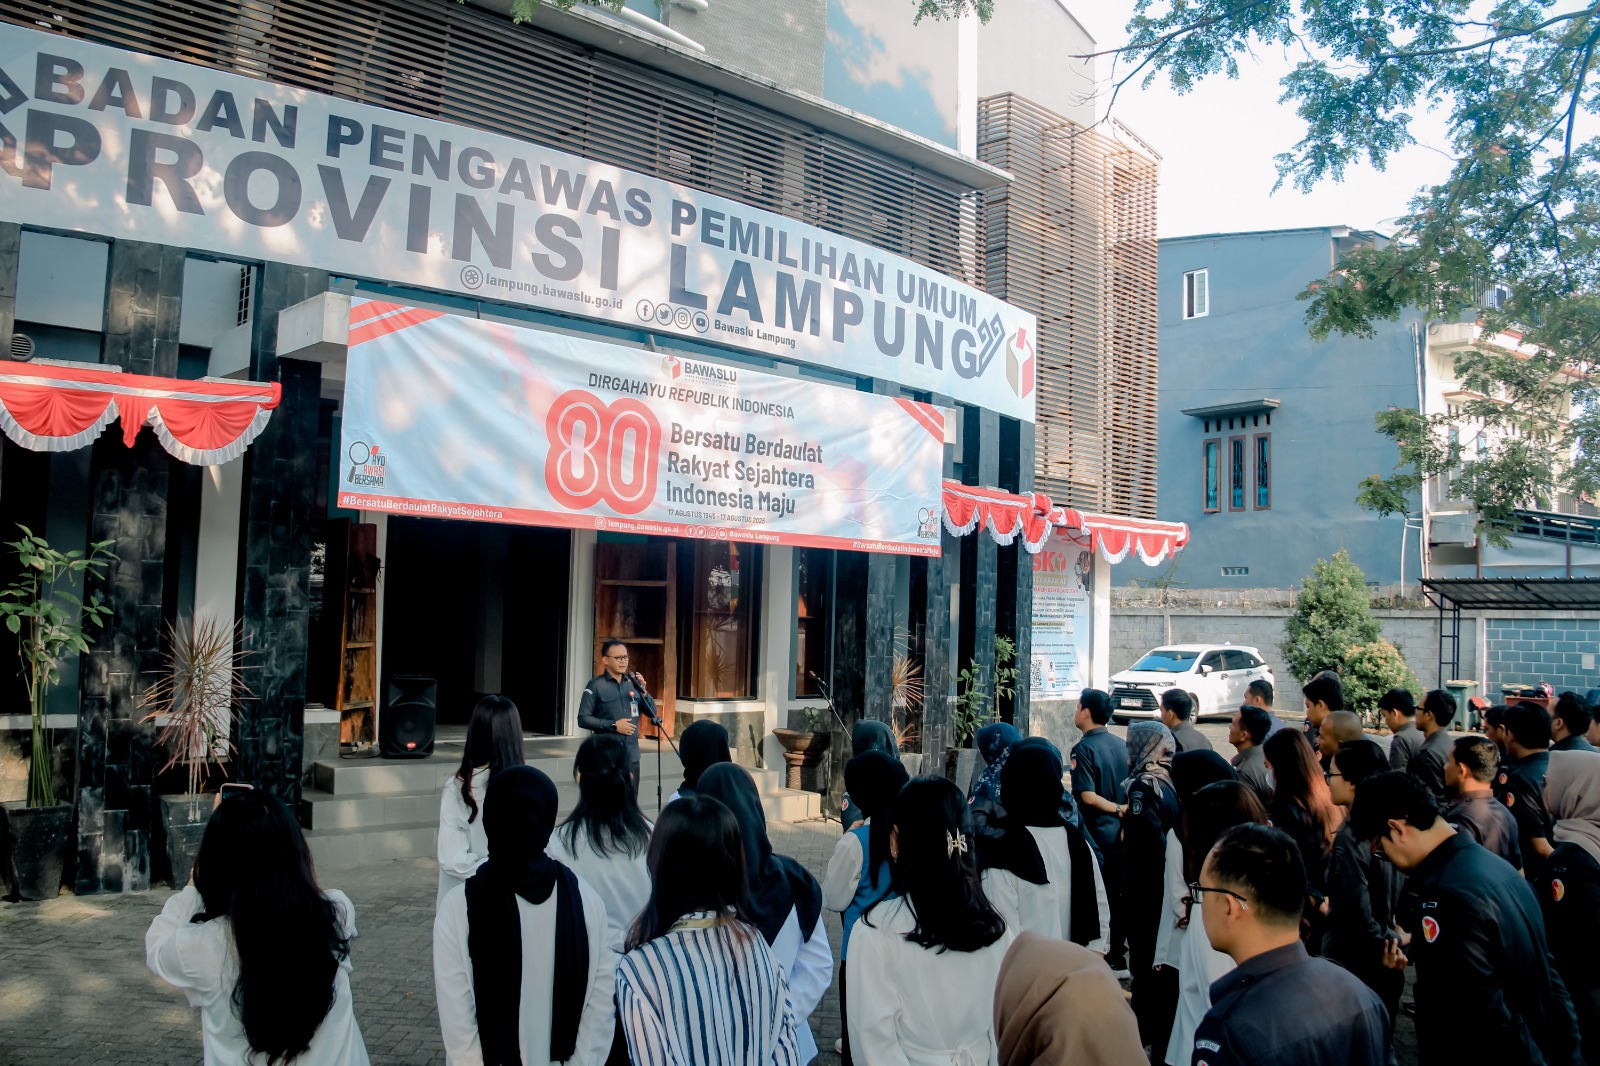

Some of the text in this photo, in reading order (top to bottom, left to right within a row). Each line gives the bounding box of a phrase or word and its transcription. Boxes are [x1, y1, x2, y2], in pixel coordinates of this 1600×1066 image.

[34, 52, 977, 327] BADAN PENGAWAS PEMILIHAN UMUM
[22, 108, 979, 379] PROVINSI LAMPUNG
[486, 273, 622, 309] lampung.bawaslu.go.id
[714, 320, 796, 348] Bawaslu Lampung
[685, 362, 736, 382] BAWASLU
[589, 373, 666, 398] DIRGAHAYU
[669, 387, 729, 409] REPUBLIK
[732, 398, 795, 419] INDONESIA
[545, 389, 661, 515] 80
[671, 422, 823, 463] Bersatu Berdaulat
[363, 464, 385, 477] AWASI
[372, 455, 386, 466] AYO
[668, 451, 815, 489] Rakyat Sejahtera
[354, 474, 384, 487] BERSAMA
[343, 495, 503, 518] #BersatuBerdaulatRakyatSejahtera
[666, 480, 796, 518] Indonesia Maju
[608, 519, 679, 534] lampung.bawaslu.go.id
[675, 510, 703, 519] AGUSTUS
[726, 514, 752, 523] AGUSTUS
[729, 530, 780, 542] Bawaslu Lampung
[853, 541, 938, 554] #BersatuBerdaulatIndonesiaMaju
